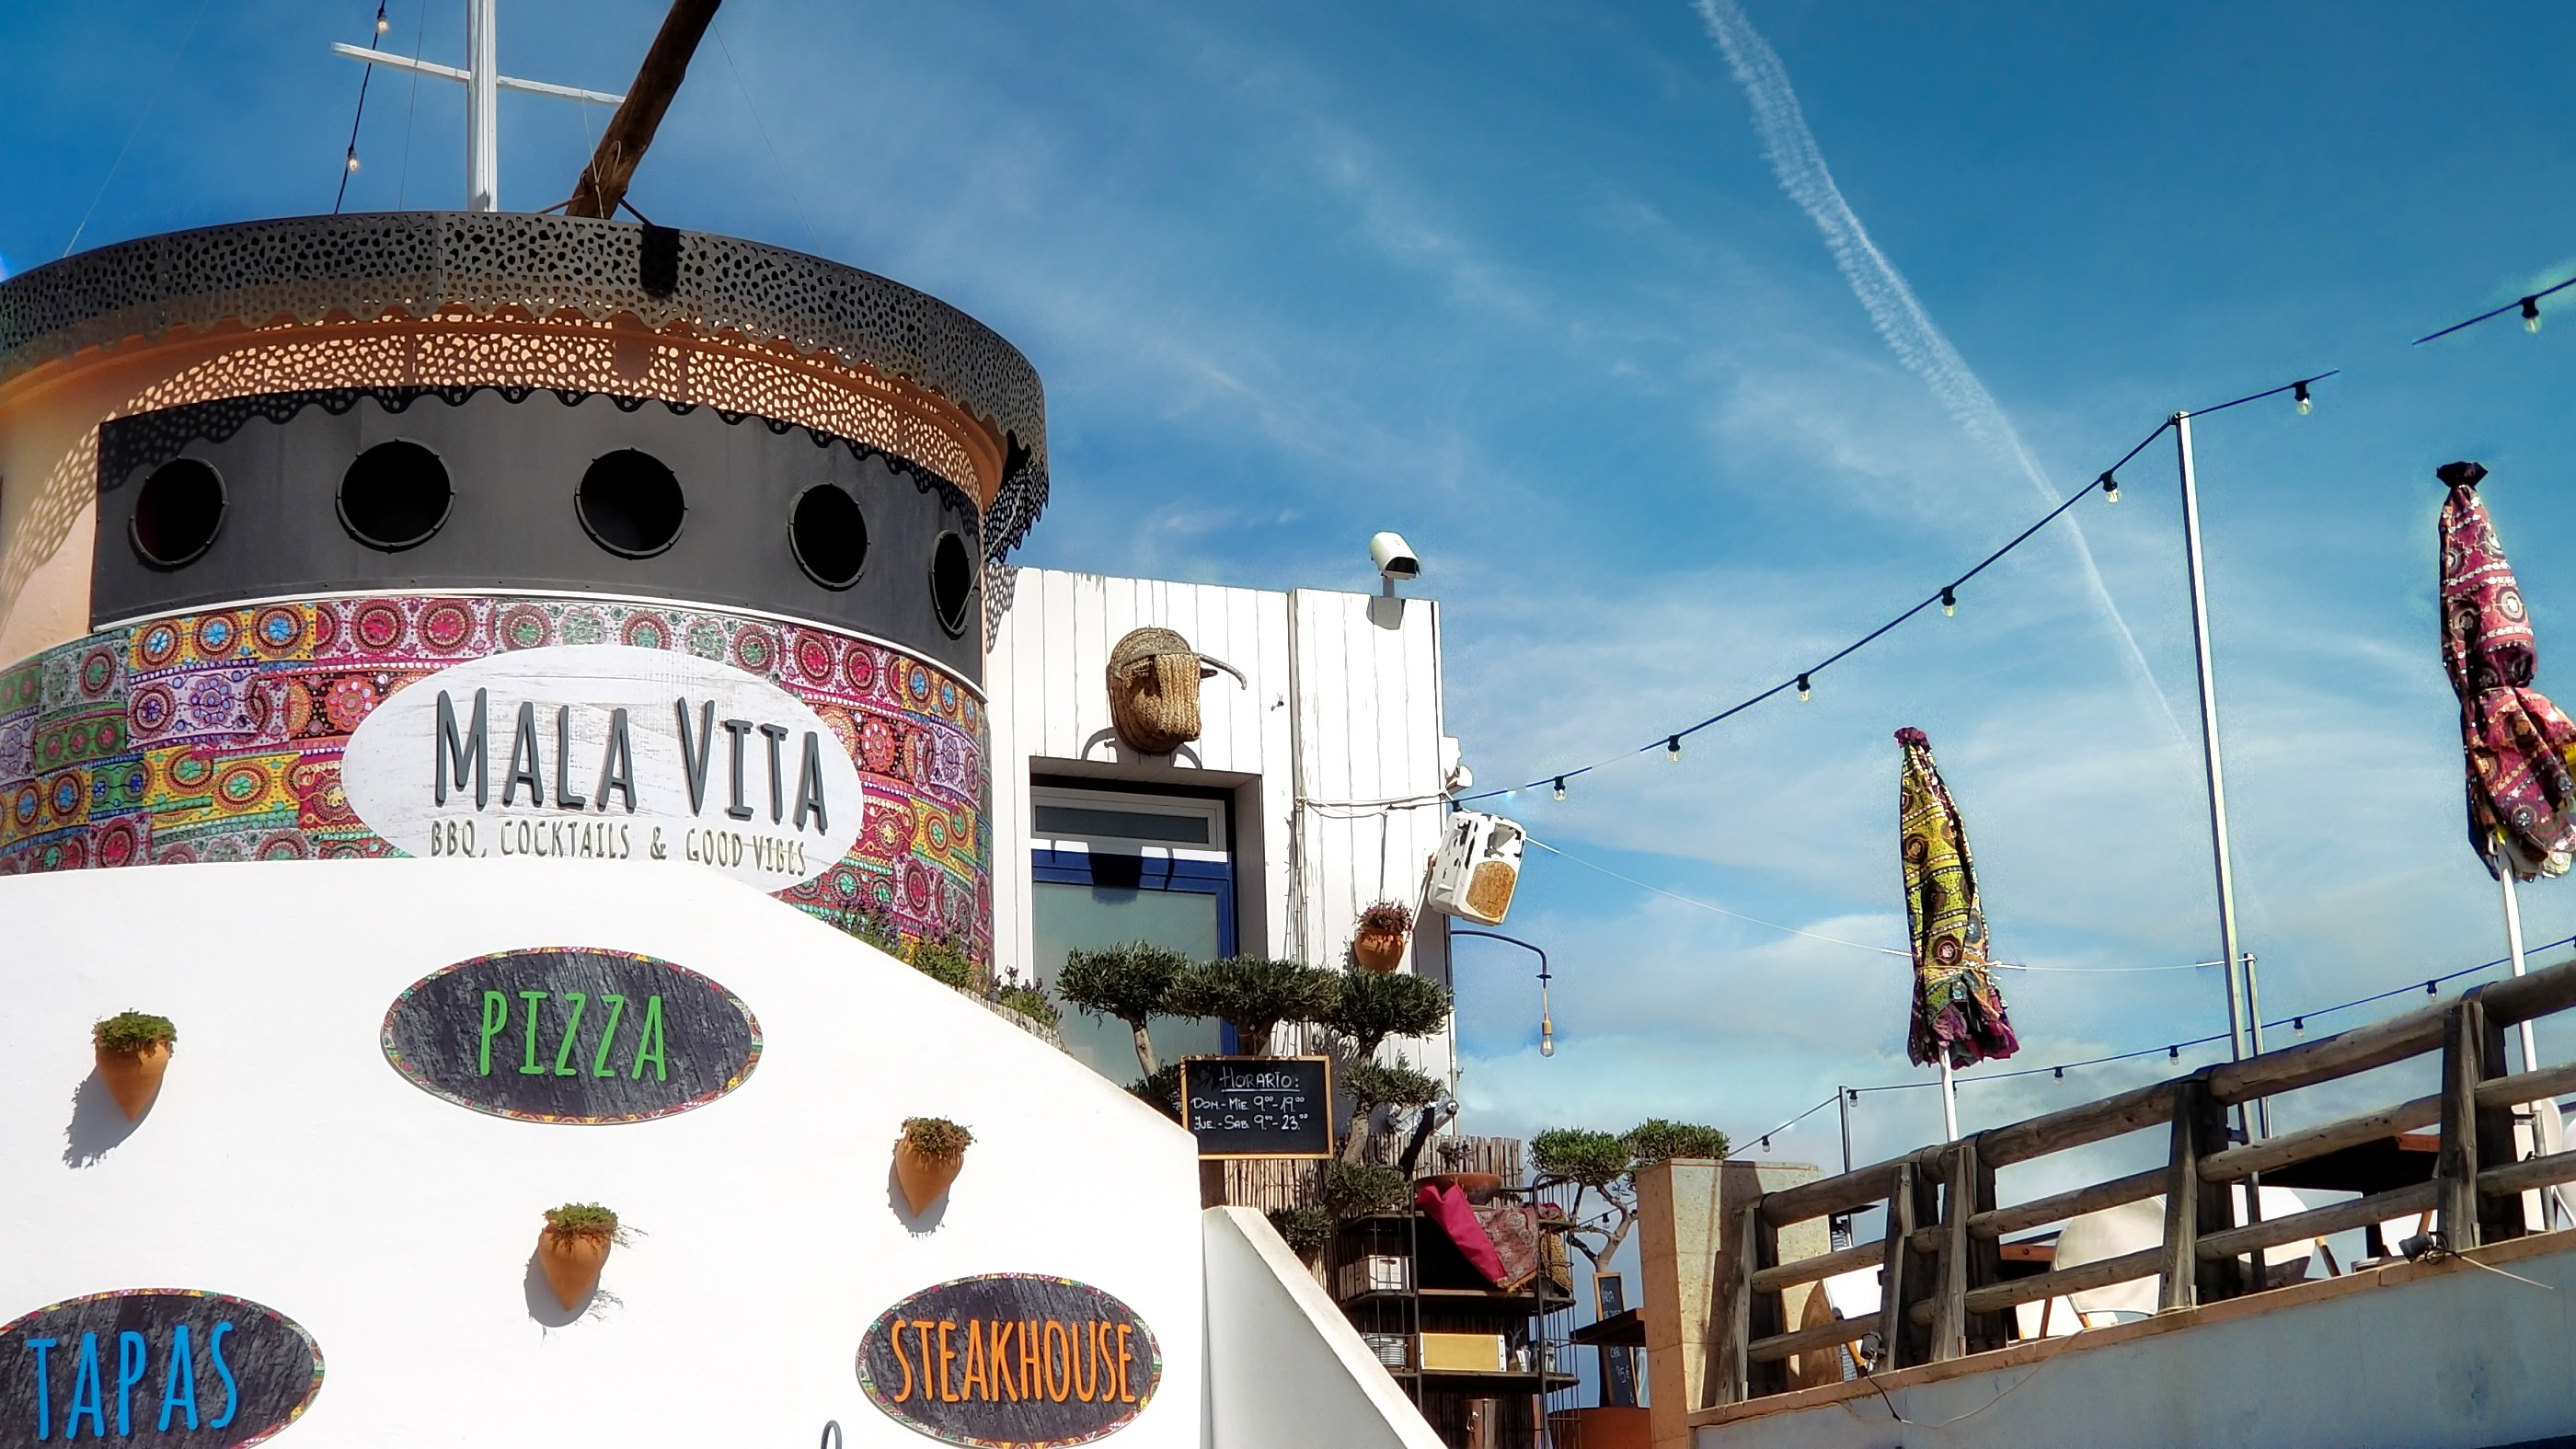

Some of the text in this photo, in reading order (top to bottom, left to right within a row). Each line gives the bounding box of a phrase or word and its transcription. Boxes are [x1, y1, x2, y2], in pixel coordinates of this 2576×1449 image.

[434, 686, 830, 836] MALA VITA
[431, 819, 807, 877] BBQ, COCKTAILS & GOOD VIBES
[478, 990, 667, 1082] PIZZA
[1219, 1065, 1299, 1089] HORARIO:
[28, 1321, 237, 1440] TAPAS
[891, 1318, 1137, 1403] STEAKHOUSE
